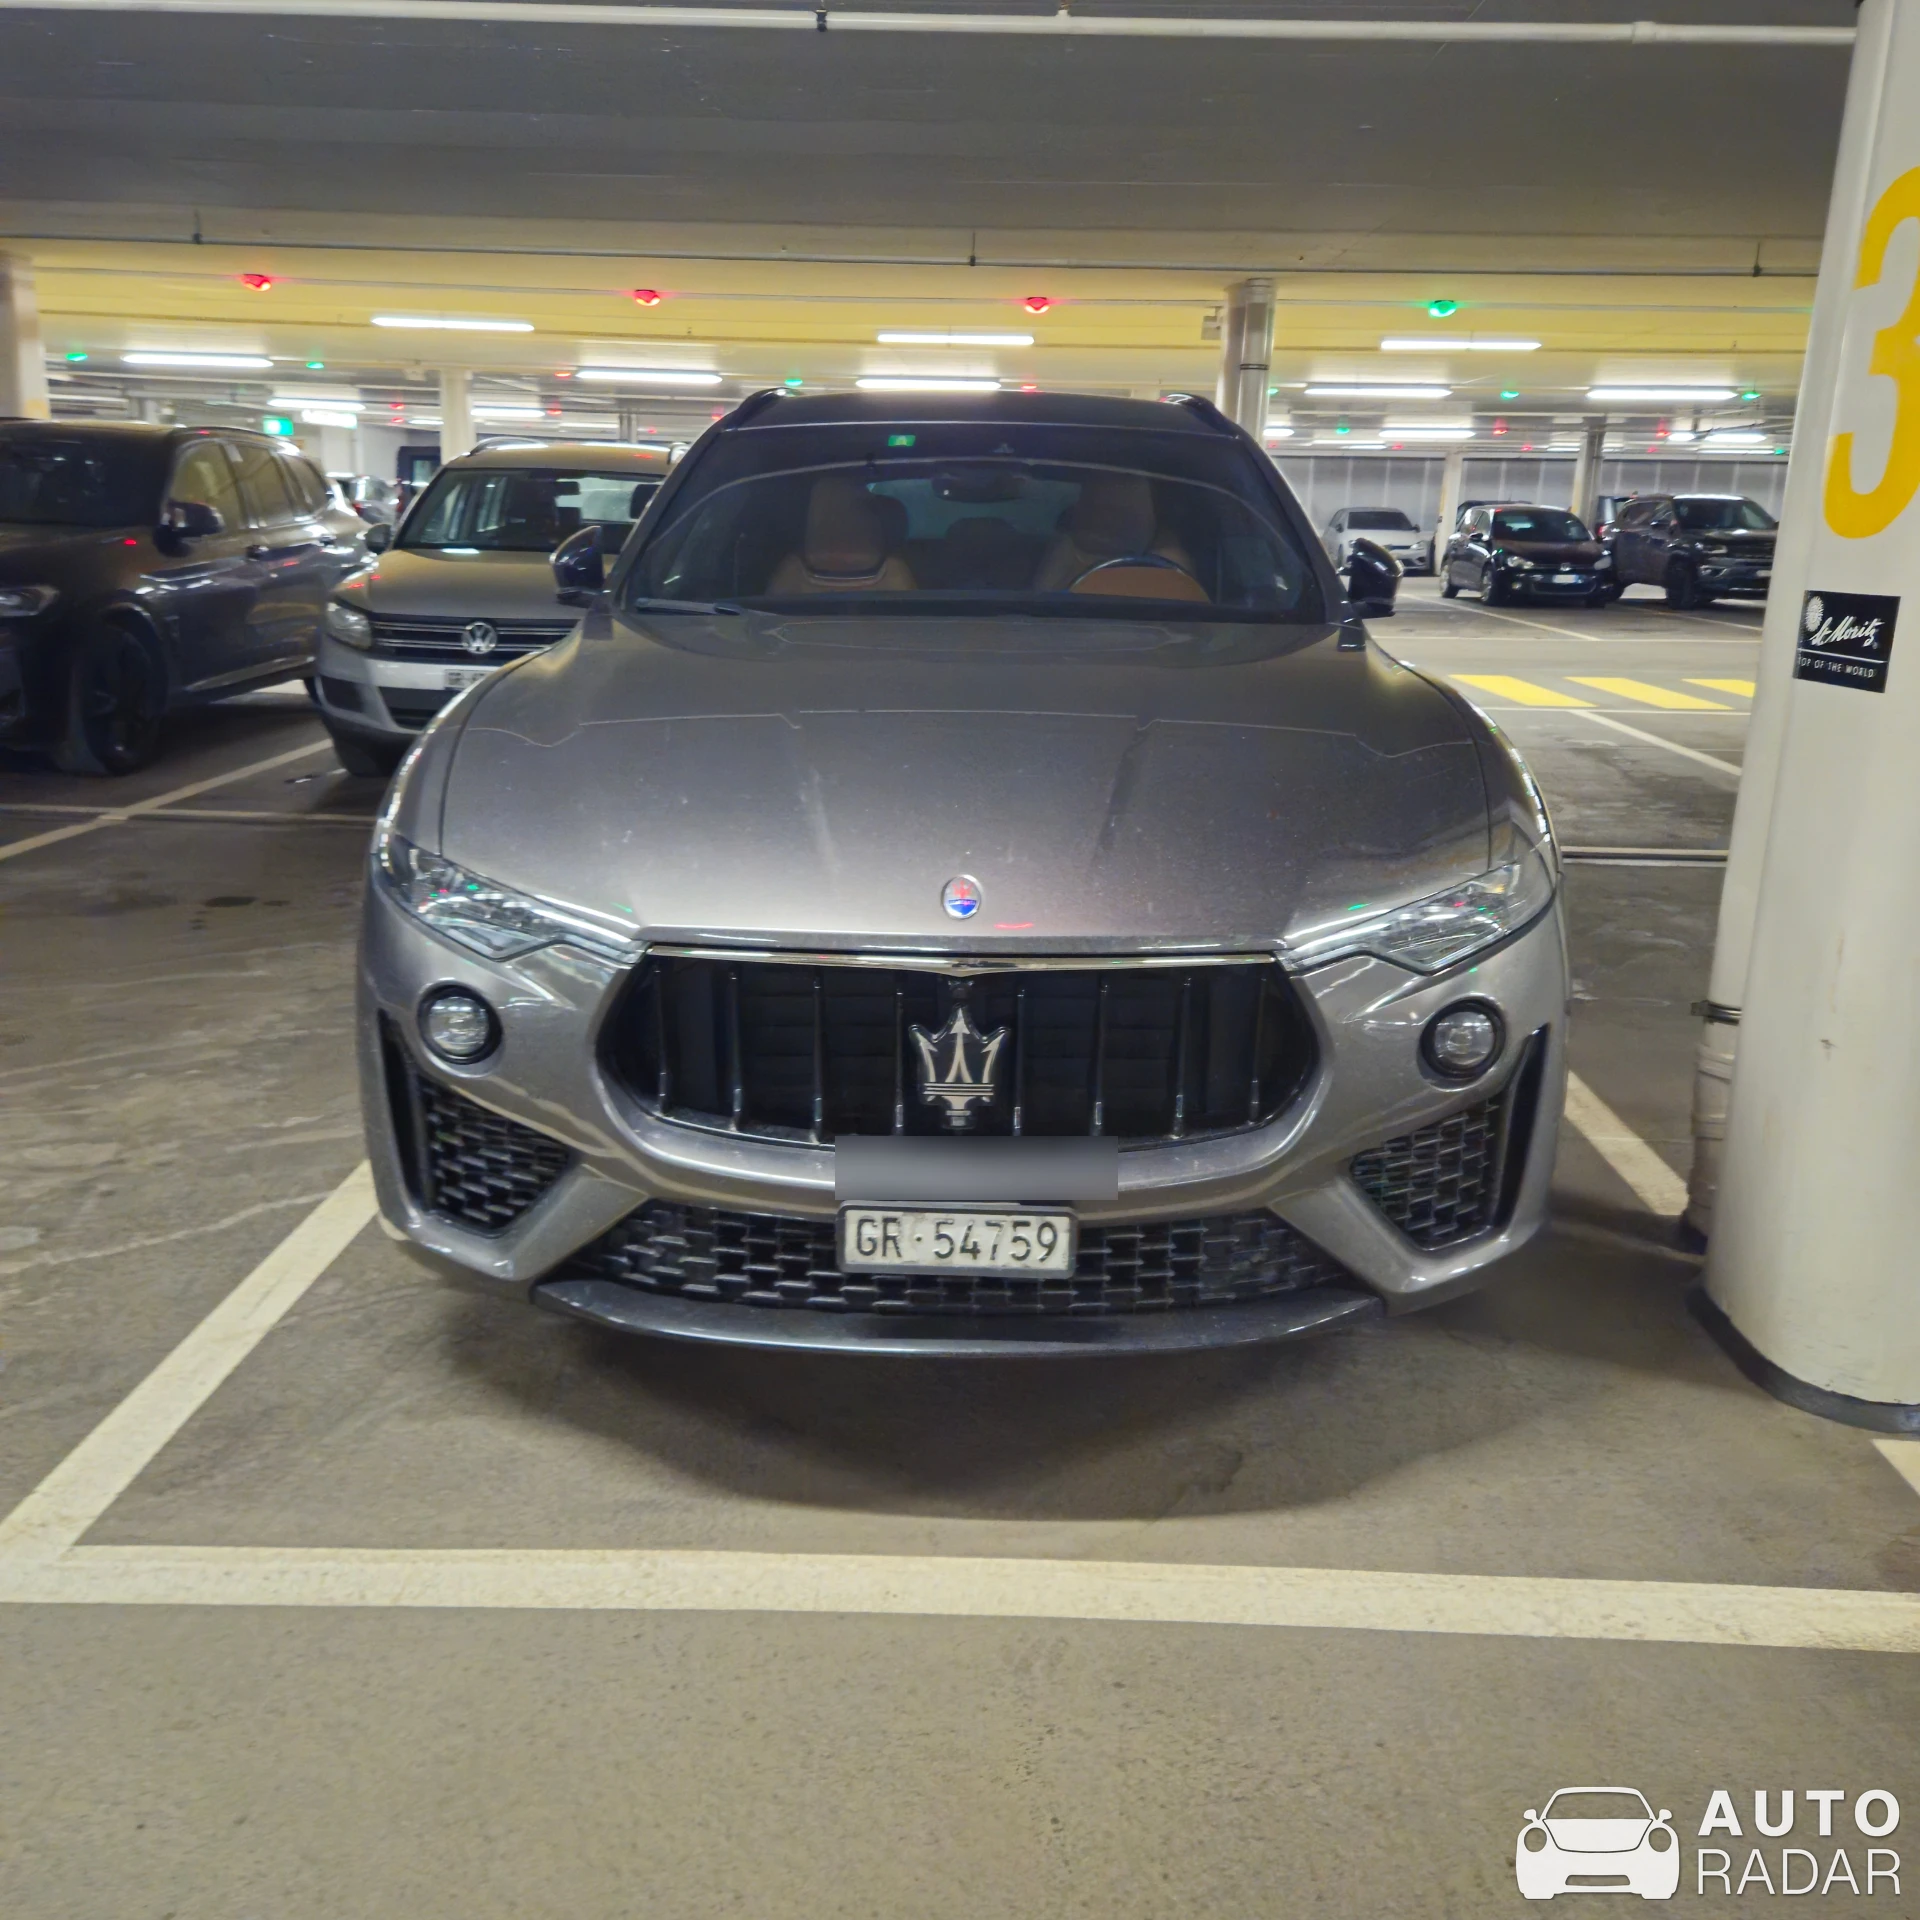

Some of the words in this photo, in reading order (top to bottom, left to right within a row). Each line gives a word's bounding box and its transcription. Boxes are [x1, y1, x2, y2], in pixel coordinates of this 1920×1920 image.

[1824, 165, 1920, 539] 3
[1826, 615, 1885, 647] Moritz
[1814, 659, 1824, 669] OF
[1828, 661, 1842, 673] THE
[1845, 664, 1874, 679] WORLD
